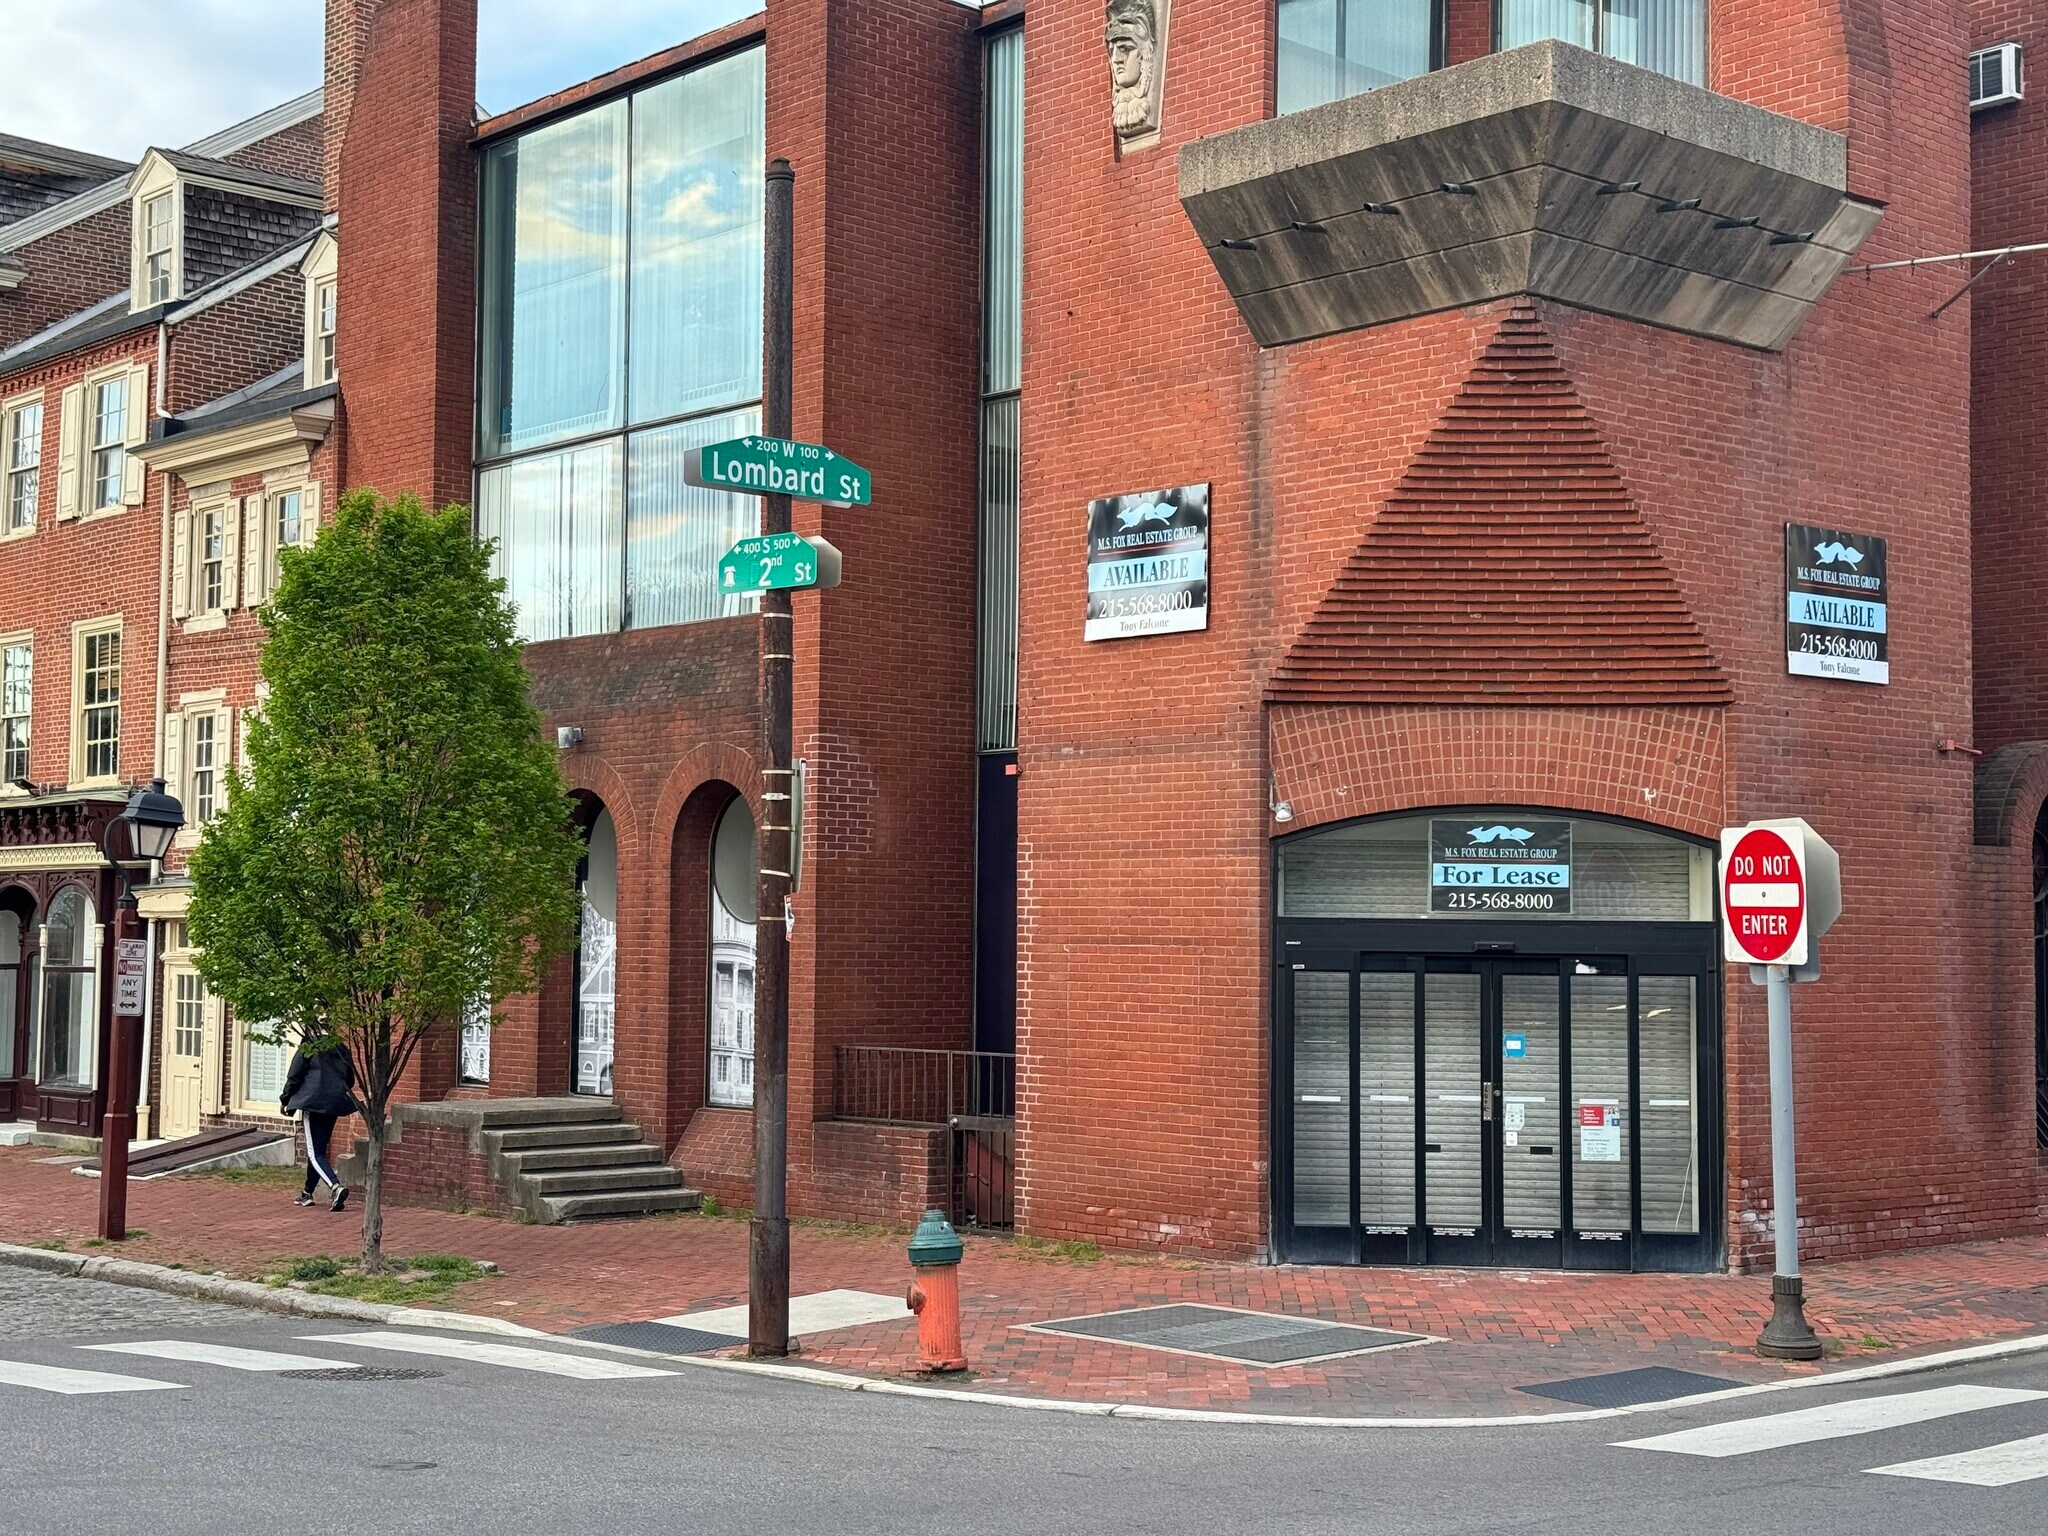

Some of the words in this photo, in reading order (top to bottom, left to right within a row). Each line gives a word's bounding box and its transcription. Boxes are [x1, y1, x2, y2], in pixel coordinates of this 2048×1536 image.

[757, 440, 778, 453] 200
[782, 442, 795, 458] W
[800, 446, 819, 459] 100
[713, 451, 824, 495] Lombard
[840, 475, 860, 500] St
[744, 543, 760, 554] 400
[762, 538, 770, 554] S
[774, 538, 790, 550] 500
[1097, 538, 1111, 550] M.S.
[1113, 535, 1126, 549] FOX
[1127, 533, 1144, 547] REAL
[1146, 529, 1173, 544] ESTATE
[1174, 526, 1197, 540] GROUP
[794, 563, 812, 582] St
[1104, 557, 1189, 587] AVAILABLE
[1797, 567, 1810, 580] M.S.
[1810, 568, 1823, 582] FOX
[1823, 570, 1838, 584] REAL
[1839, 572, 1860, 588] ESTATE
[1860, 576, 1880, 591] GROUP
[1099, 590, 1192, 618] 215-568-8000
[1803, 599, 1875, 628] AVAILABLE
[1120, 621, 1137, 632] Tony
[1139, 617, 1170, 630] Falcone
[1800, 632, 1878, 660] 215-568-8000
[1820, 661, 1836, 674] Tony
[1837, 663, 1861, 675] Falcone
[1445, 848, 1460, 858] M.S.
[1461, 848, 1478, 858] FOX
[1478, 848, 1499, 858] REAL
[1500, 849, 1529, 859] ESTATE
[1530, 849, 1558, 859] GROUP
[1441, 865, 1483, 884] For
[1491, 866, 1561, 885] Lease
[1734, 856, 1754, 876] DO
[1762, 855, 1791, 876] NOT
[1448, 892, 1554, 910] 215-568-8000
[1742, 914, 1788, 936] ENTER
[119, 961, 127, 972] NO
[121, 979, 138, 987] ANY
[120, 990, 138, 998] TIME
